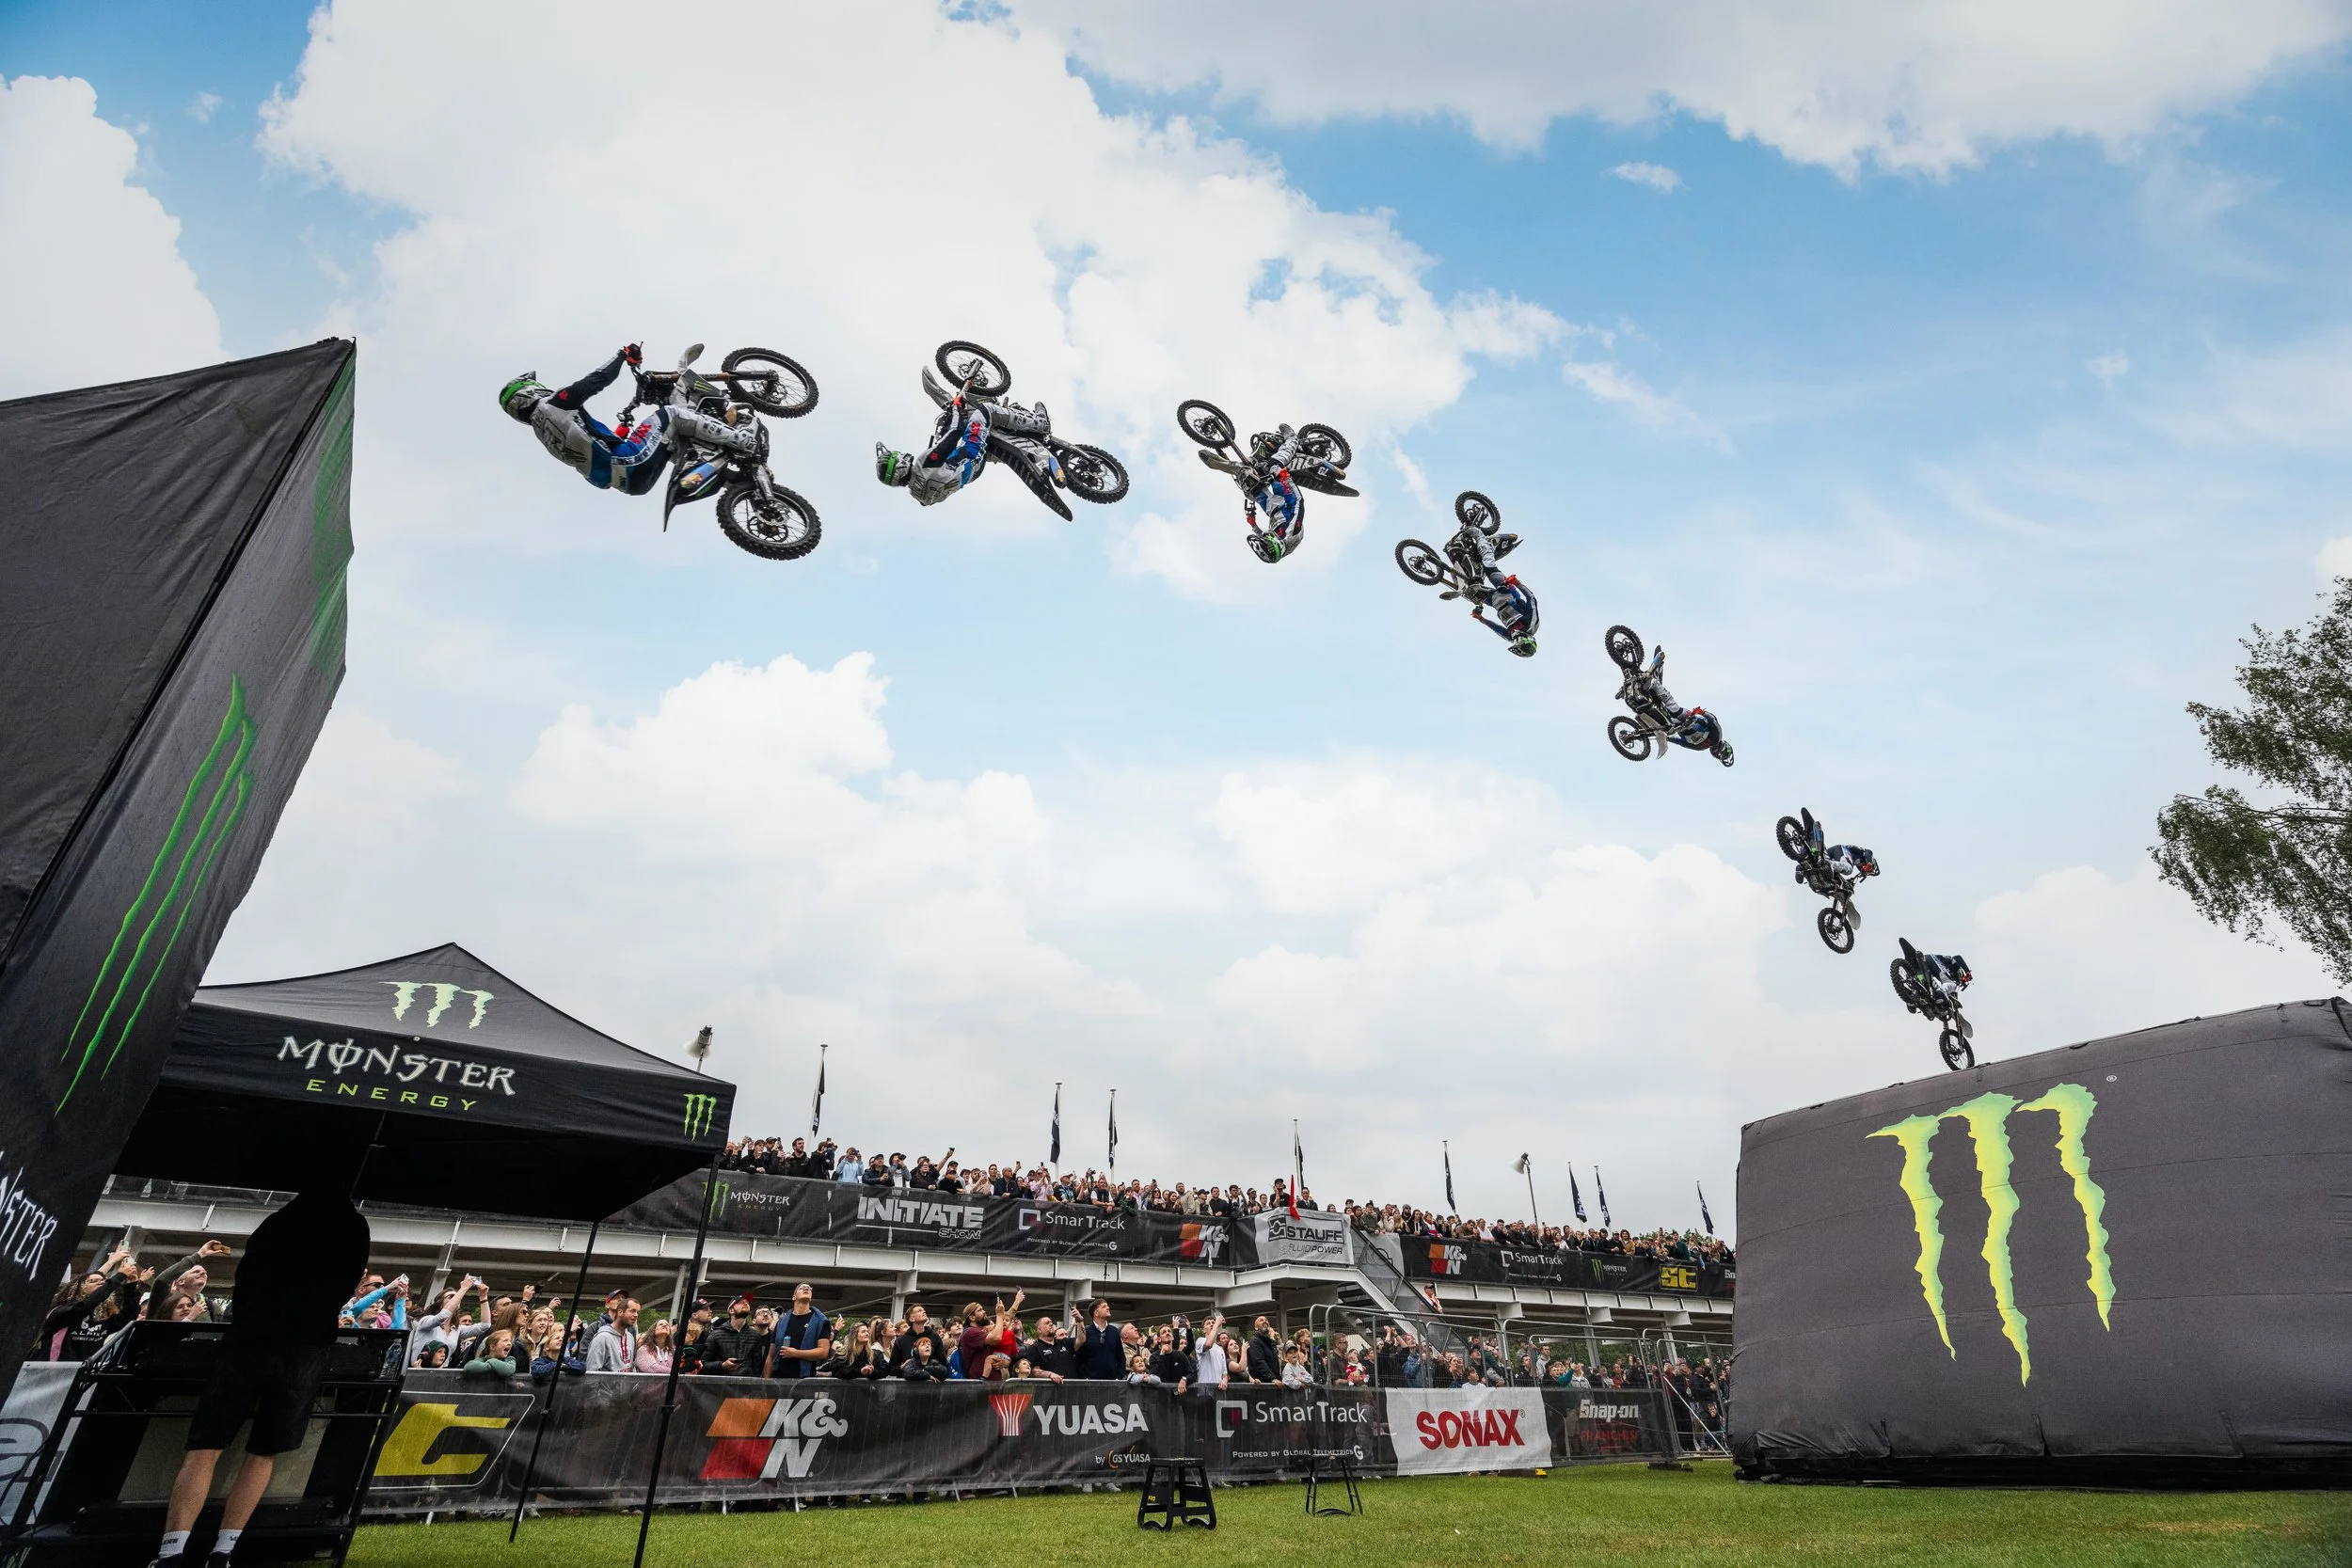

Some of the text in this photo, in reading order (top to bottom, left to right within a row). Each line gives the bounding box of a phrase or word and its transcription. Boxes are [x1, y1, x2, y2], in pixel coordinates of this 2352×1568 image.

[277, 1036, 516, 1096] MONSTER
[306, 1079, 478, 1111] ENERGY
[730, 1191, 790, 1206] MONSTER
[857, 1196, 984, 1228] INITIATE
[0, 1163, 58, 1281] NSTER
[938, 1227, 981, 1240] SHOW
[1287, 1226, 1343, 1241] STAUFF
[1443, 1244, 1467, 1261] K&
[1446, 1260, 1461, 1275] N
[759, 1398, 848, 1437] K&
[1033, 1403, 1149, 1435] YUASA
[1580, 1399, 1639, 1422] Snap-on
[759, 1438, 822, 1478] N
[1095, 1455, 1105, 1465] by
